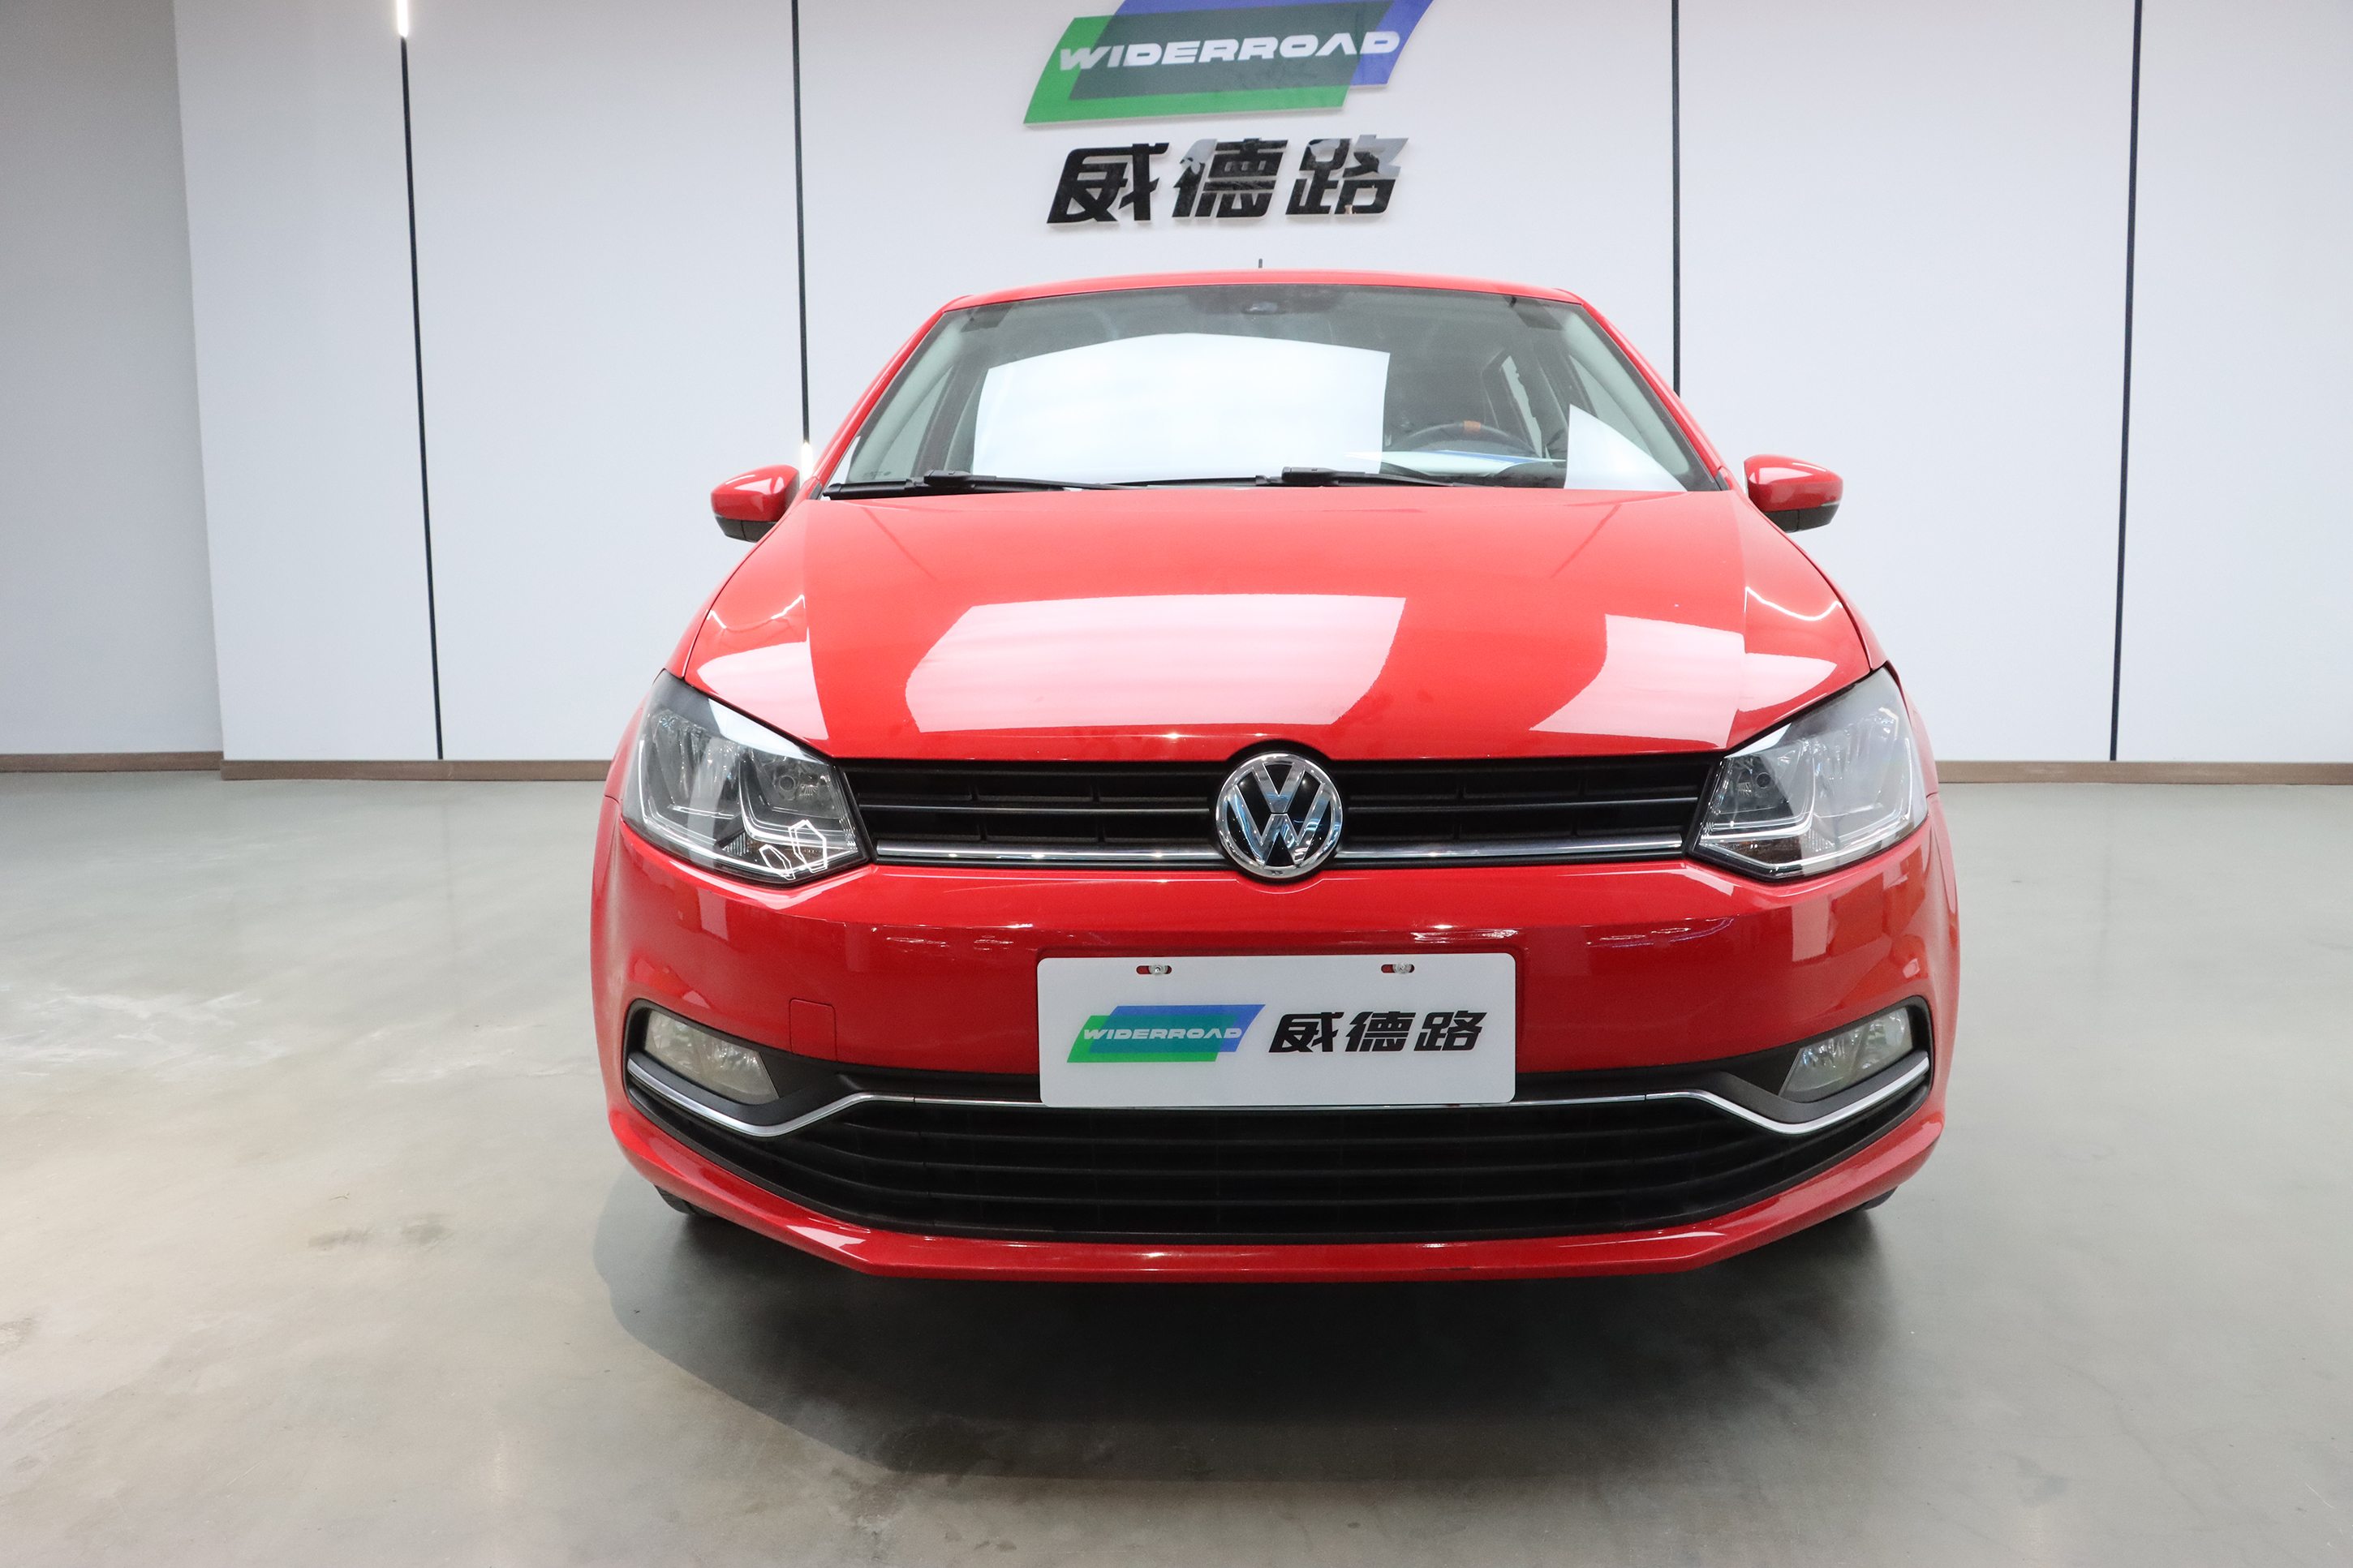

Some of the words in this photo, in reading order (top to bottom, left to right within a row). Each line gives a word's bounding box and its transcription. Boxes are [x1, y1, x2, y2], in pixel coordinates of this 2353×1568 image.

[1060, 31, 1400, 71] WIDERROAD
[1047, 135, 1409, 224] 威德路
[1083, 1028, 1242, 1040] WIDERROAD
[1268, 1012, 1486, 1052] 威德路
